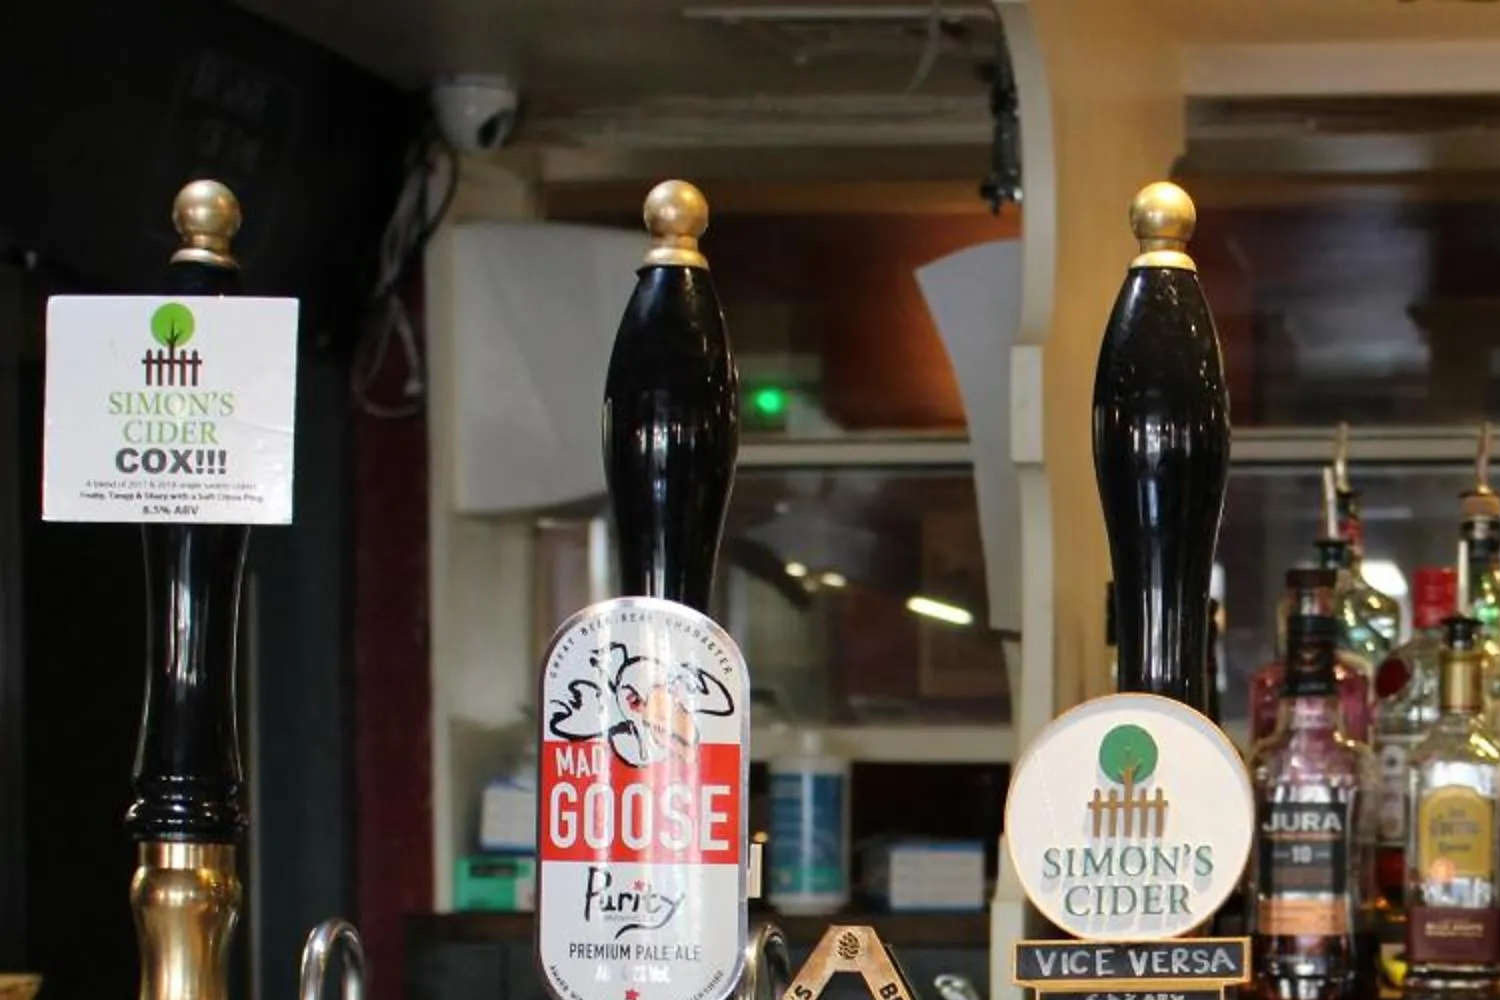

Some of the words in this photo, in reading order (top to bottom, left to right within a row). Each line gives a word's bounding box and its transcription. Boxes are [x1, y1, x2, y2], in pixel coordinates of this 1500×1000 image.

[108, 391, 235, 417] SIMON'S
[122, 420, 220, 445] CIDER
[115, 447, 227, 475] COX!!!
[555, 745, 609, 780] MAD
[550, 781, 731, 854] GOOSE
[1263, 811, 1342, 832] JURA
[1042, 843, 1215, 879] SIMON'S
[584, 865, 686, 941] Purity
[1063, 884, 1193, 917] CIDER
[569, 943, 631, 960] PREMIUM
[634, 944, 671, 961] PALE
[675, 944, 703, 961] ALE
[1034, 947, 1115, 977] VICE
[1128, 946, 1237, 977] VERSA
